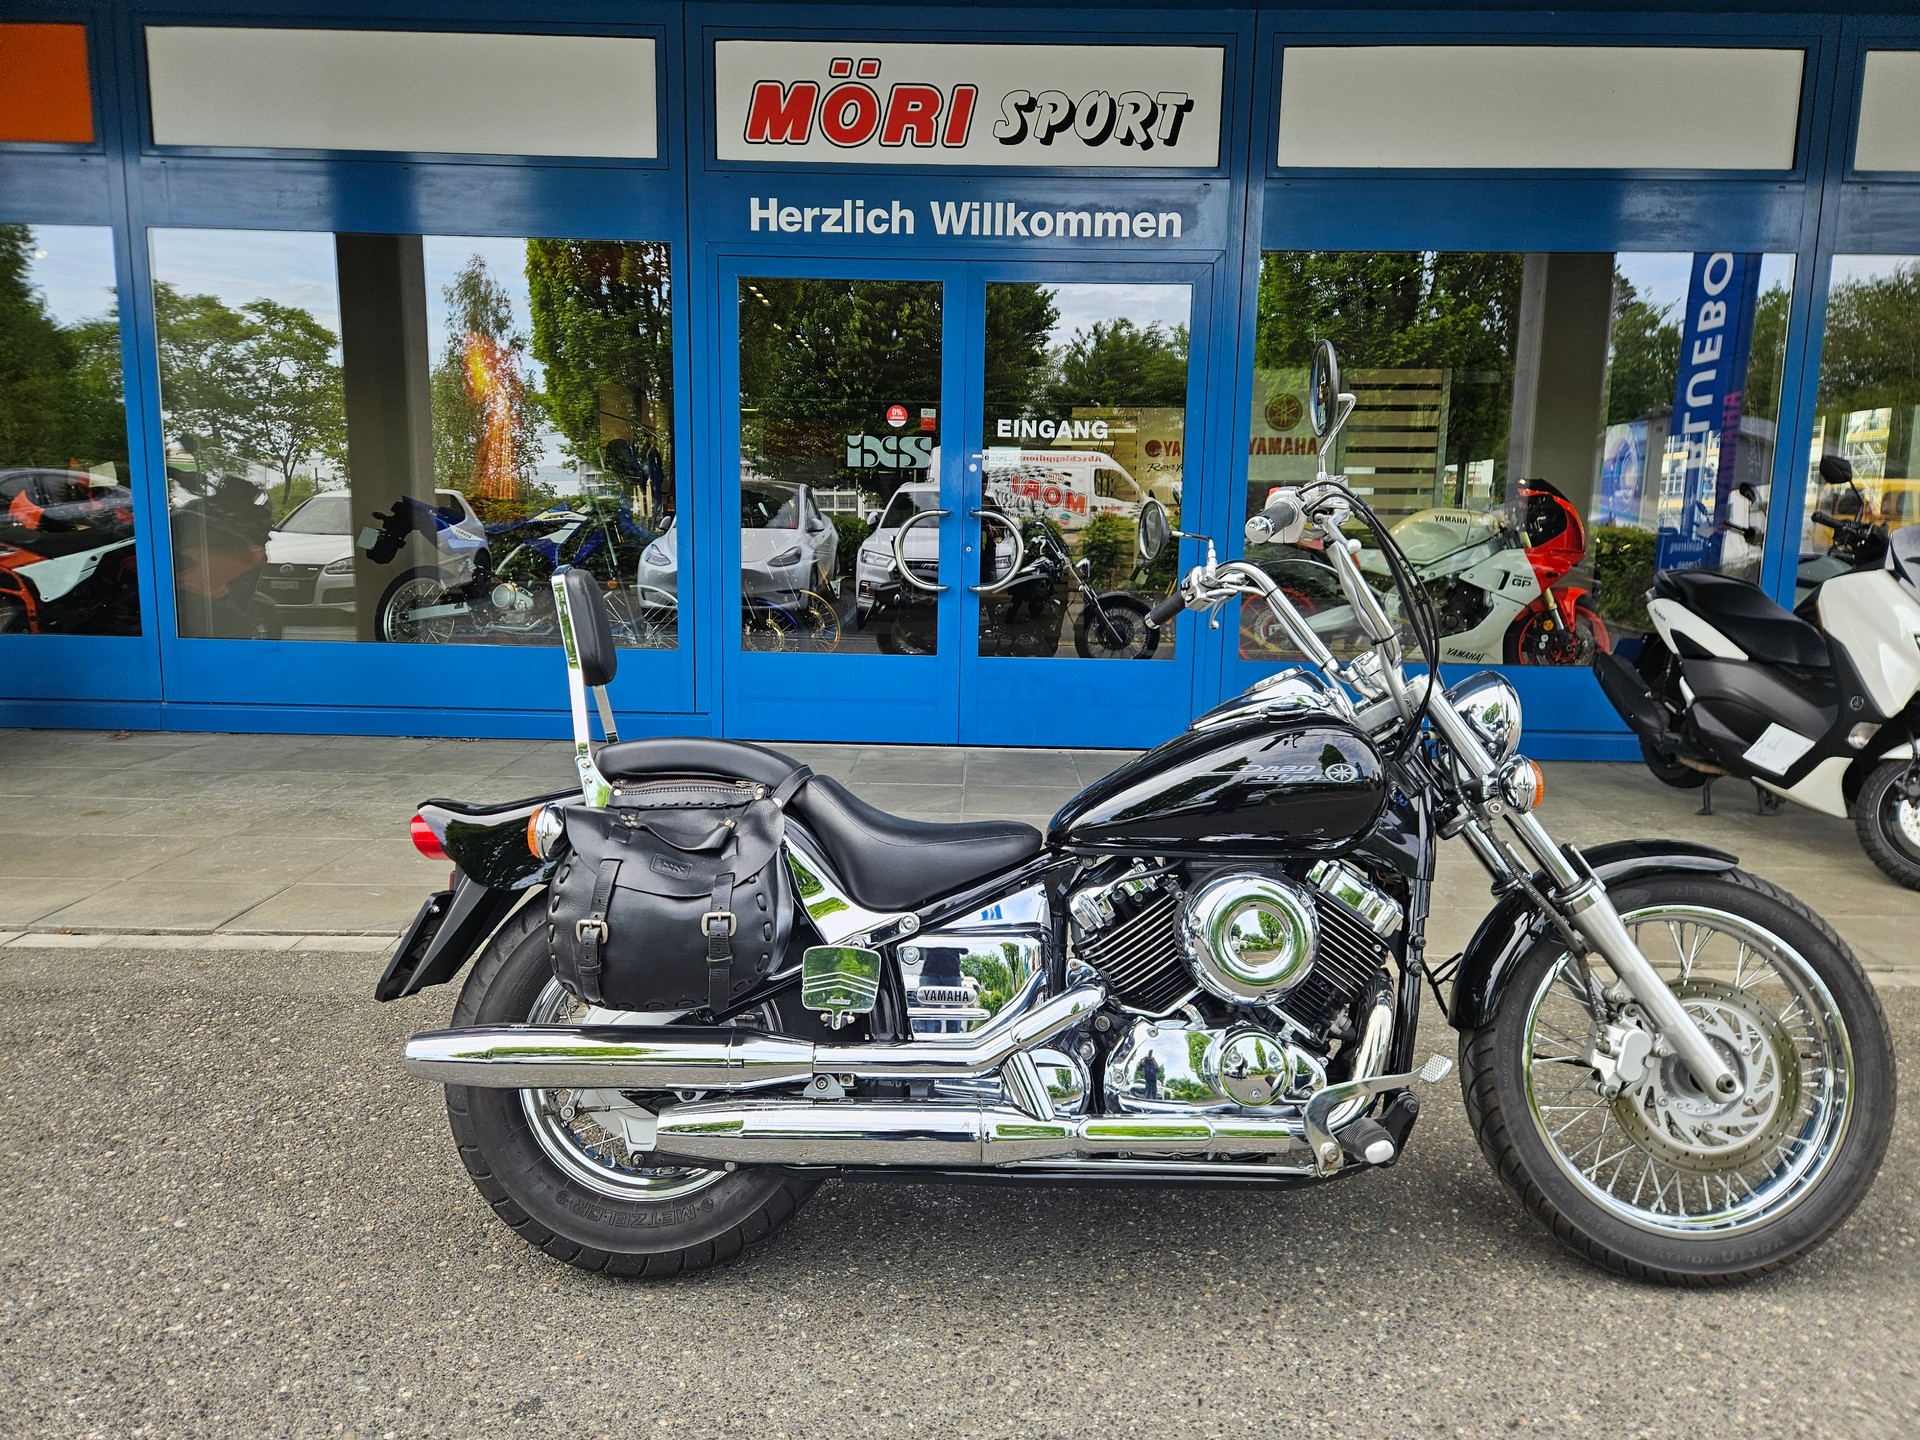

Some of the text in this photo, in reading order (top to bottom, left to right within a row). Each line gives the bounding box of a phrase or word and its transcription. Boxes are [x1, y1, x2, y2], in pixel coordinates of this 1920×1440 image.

[744, 58, 1194, 150] MÖRI SPORT
[750, 197, 1182, 239] Herzlich Willkommen
[997, 419, 1109, 439] EINGANG
[1249, 437, 1317, 456] YAMAHA
[1434, 515, 1468, 525] YAMAHA
[1512, 578, 1532, 588] GP
[1447, 647, 1483, 662] YAMAHA
[923, 989, 969, 1002] YAMAHA
[572, 1197, 697, 1229] METZELER
